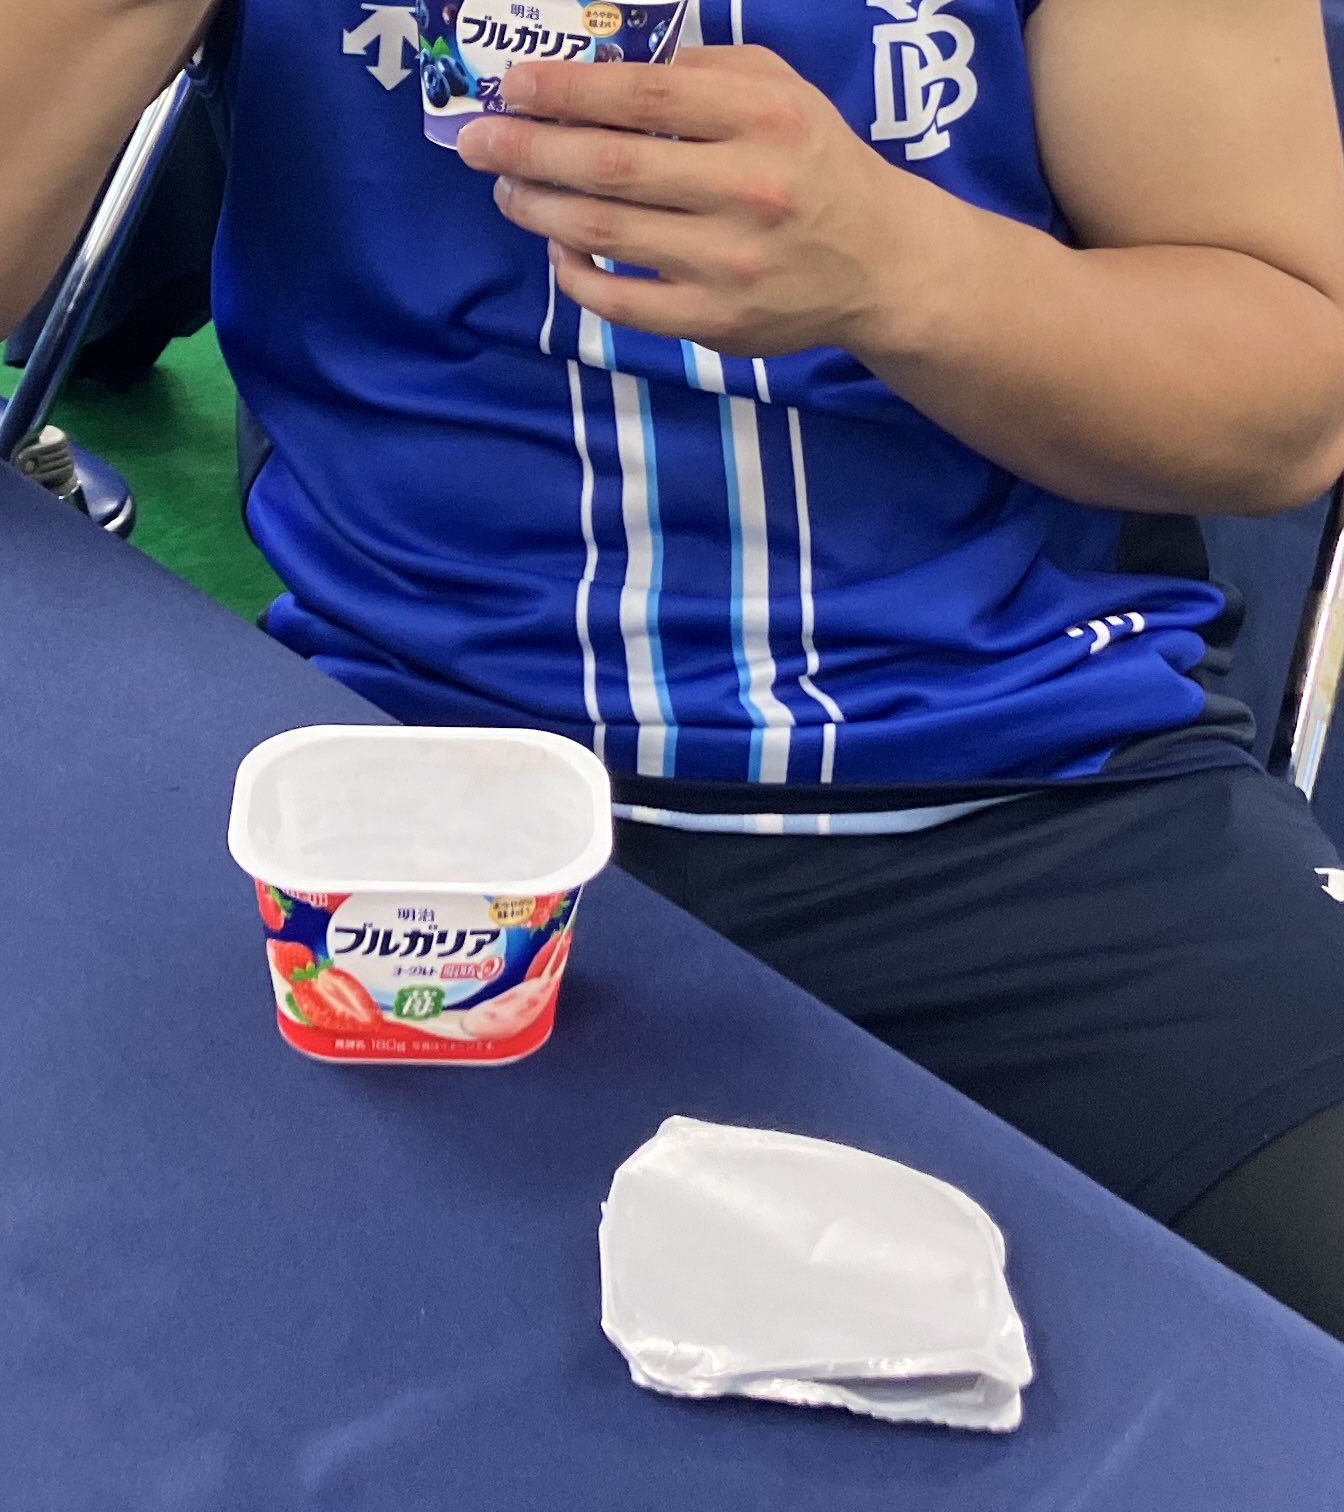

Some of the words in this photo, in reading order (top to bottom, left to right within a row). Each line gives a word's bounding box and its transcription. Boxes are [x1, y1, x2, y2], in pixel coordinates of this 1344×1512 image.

[511, 3, 540, 20] 明治
[462, 16, 592, 60] ブルガリア
[397, 907, 436, 922] 明治
[334, 922, 501, 957] ブルガリア
[371, 1038, 407, 1052] 180g
